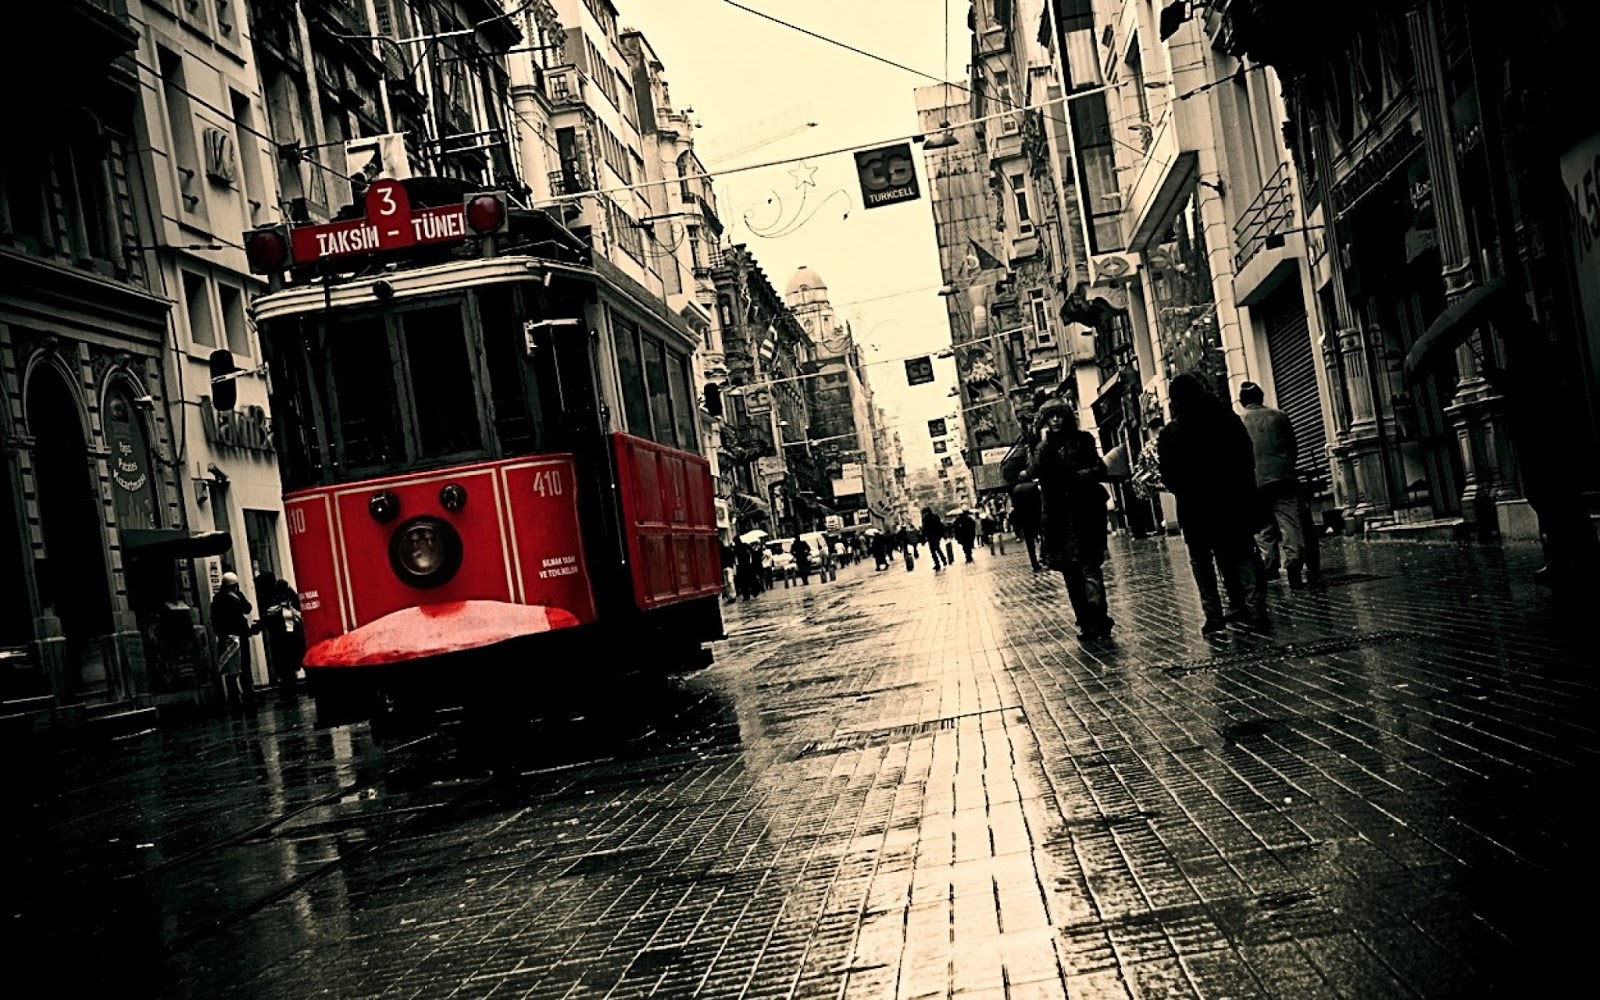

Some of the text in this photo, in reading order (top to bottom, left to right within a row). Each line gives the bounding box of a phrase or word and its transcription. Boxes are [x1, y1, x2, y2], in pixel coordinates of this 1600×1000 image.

[376, 186, 397, 216] 3
[868, 187, 915, 203] TURKCELL
[532, 469, 563, 498] 410
